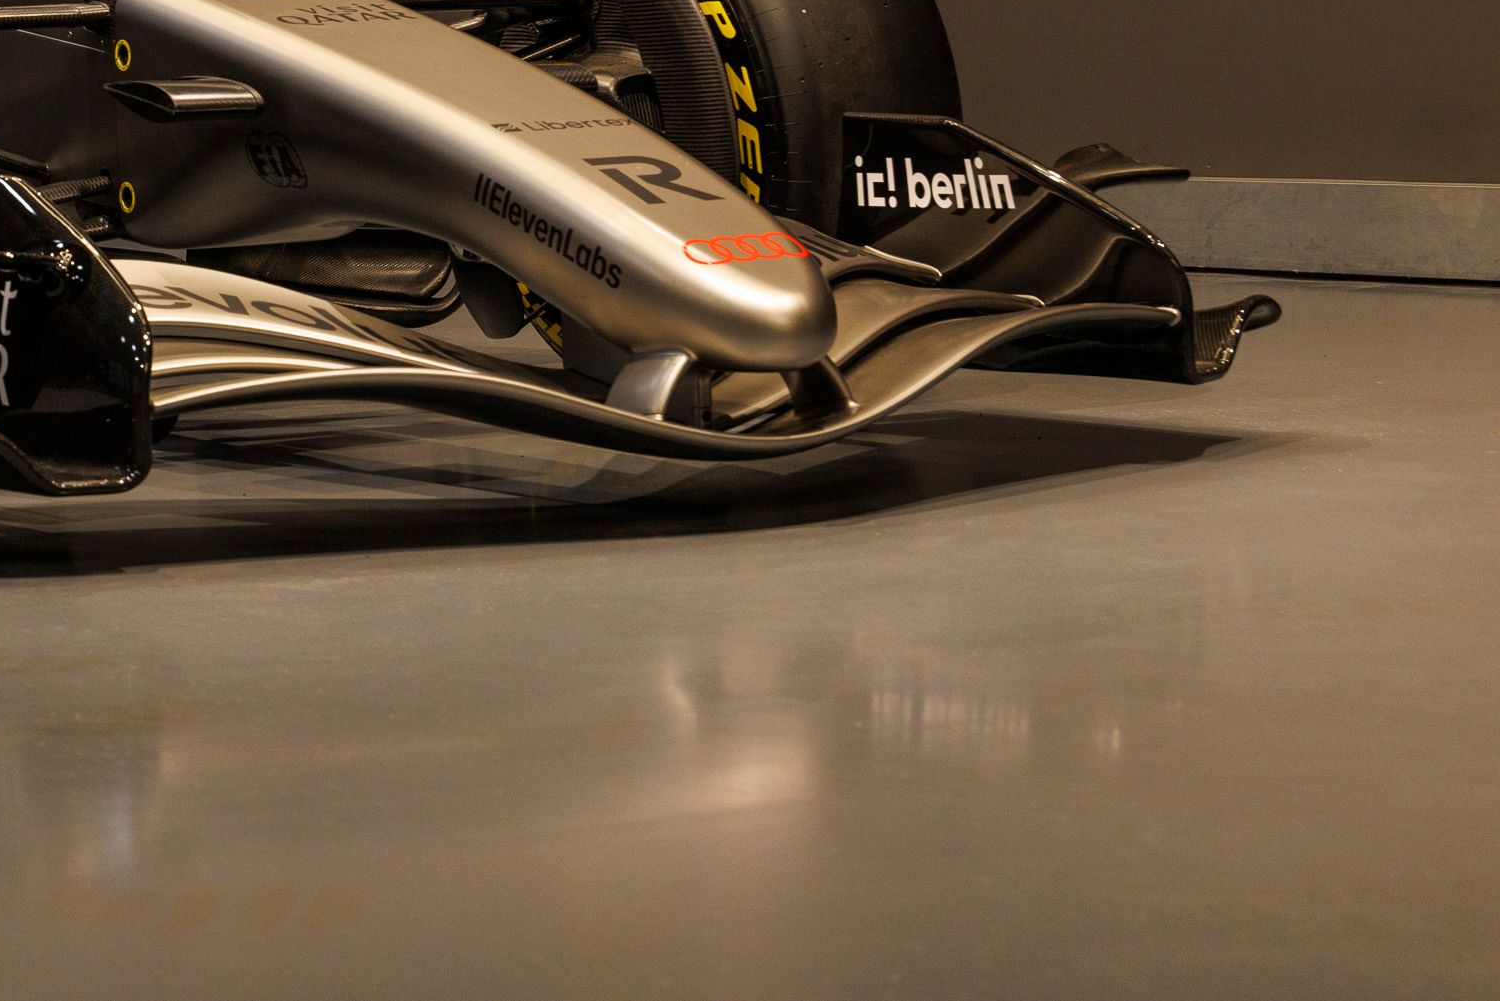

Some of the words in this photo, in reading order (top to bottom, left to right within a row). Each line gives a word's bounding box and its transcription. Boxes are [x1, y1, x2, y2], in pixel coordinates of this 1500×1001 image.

[298, 2, 397, 16] visit
[276, 10, 418, 26] QATAR
[700, 0, 736, 40] P
[723, 61, 765, 205] ZER
[521, 116, 633, 132] Libertex
[904, 156, 1017, 210] berlin
